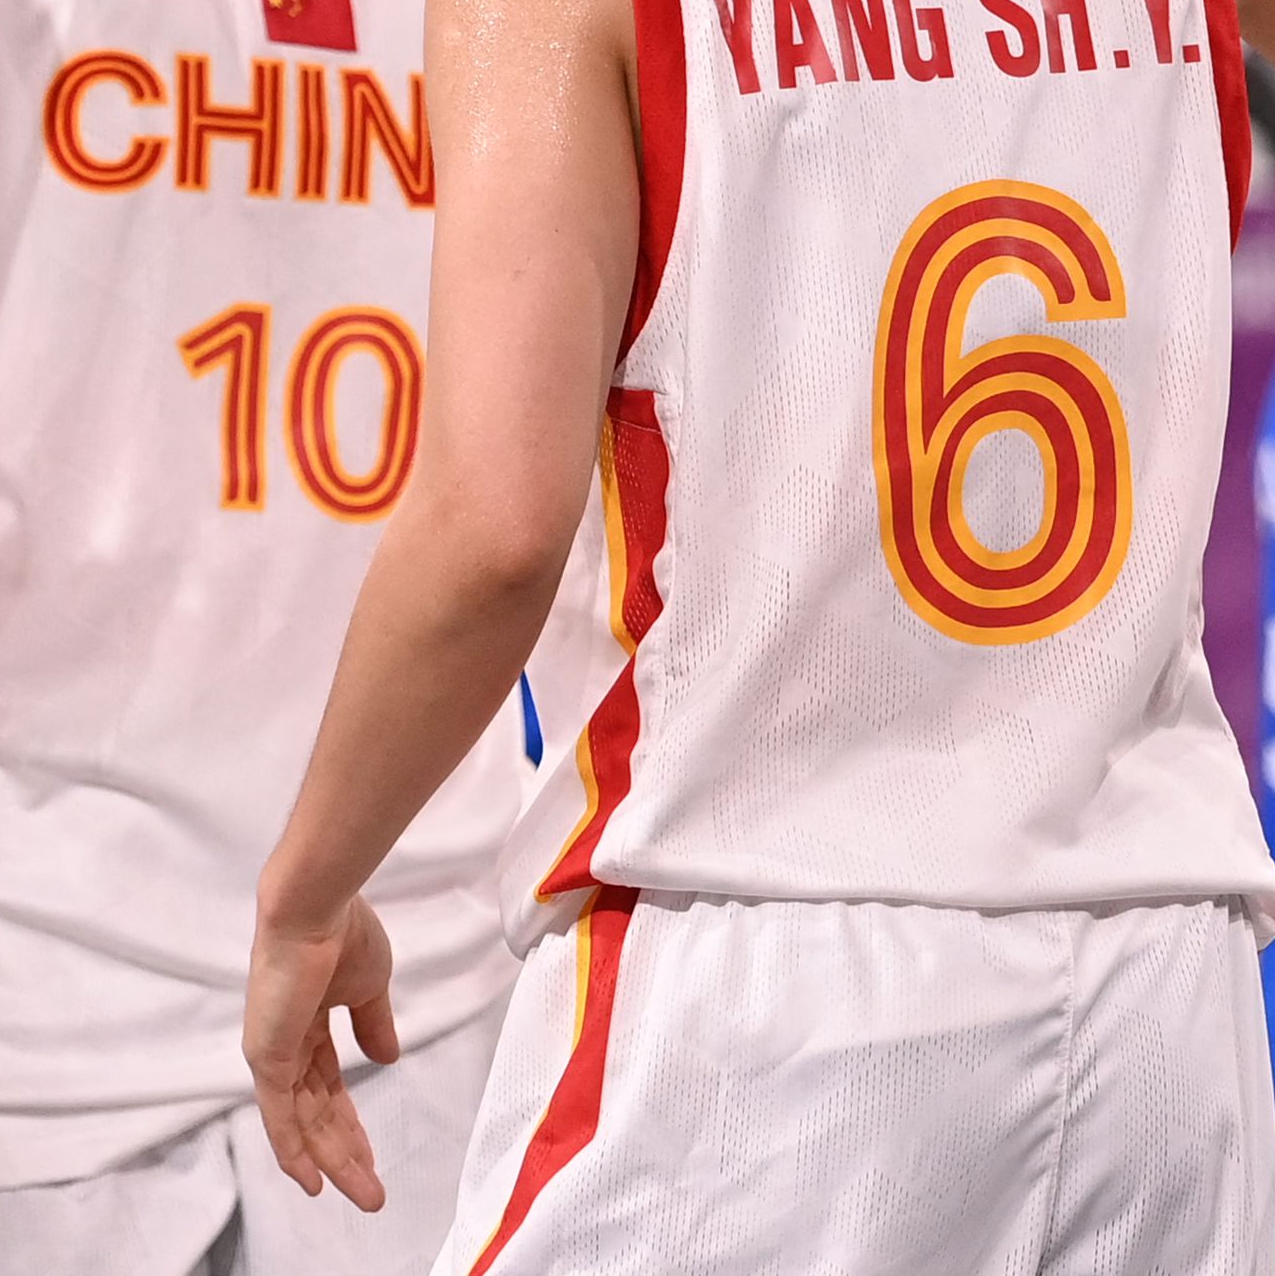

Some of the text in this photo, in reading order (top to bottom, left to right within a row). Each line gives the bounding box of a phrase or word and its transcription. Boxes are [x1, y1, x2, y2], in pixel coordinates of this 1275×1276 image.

[42, 49, 436, 210] CHIN
[176, 302, 426, 523] 10
[871, 178, 1134, 647] 6
